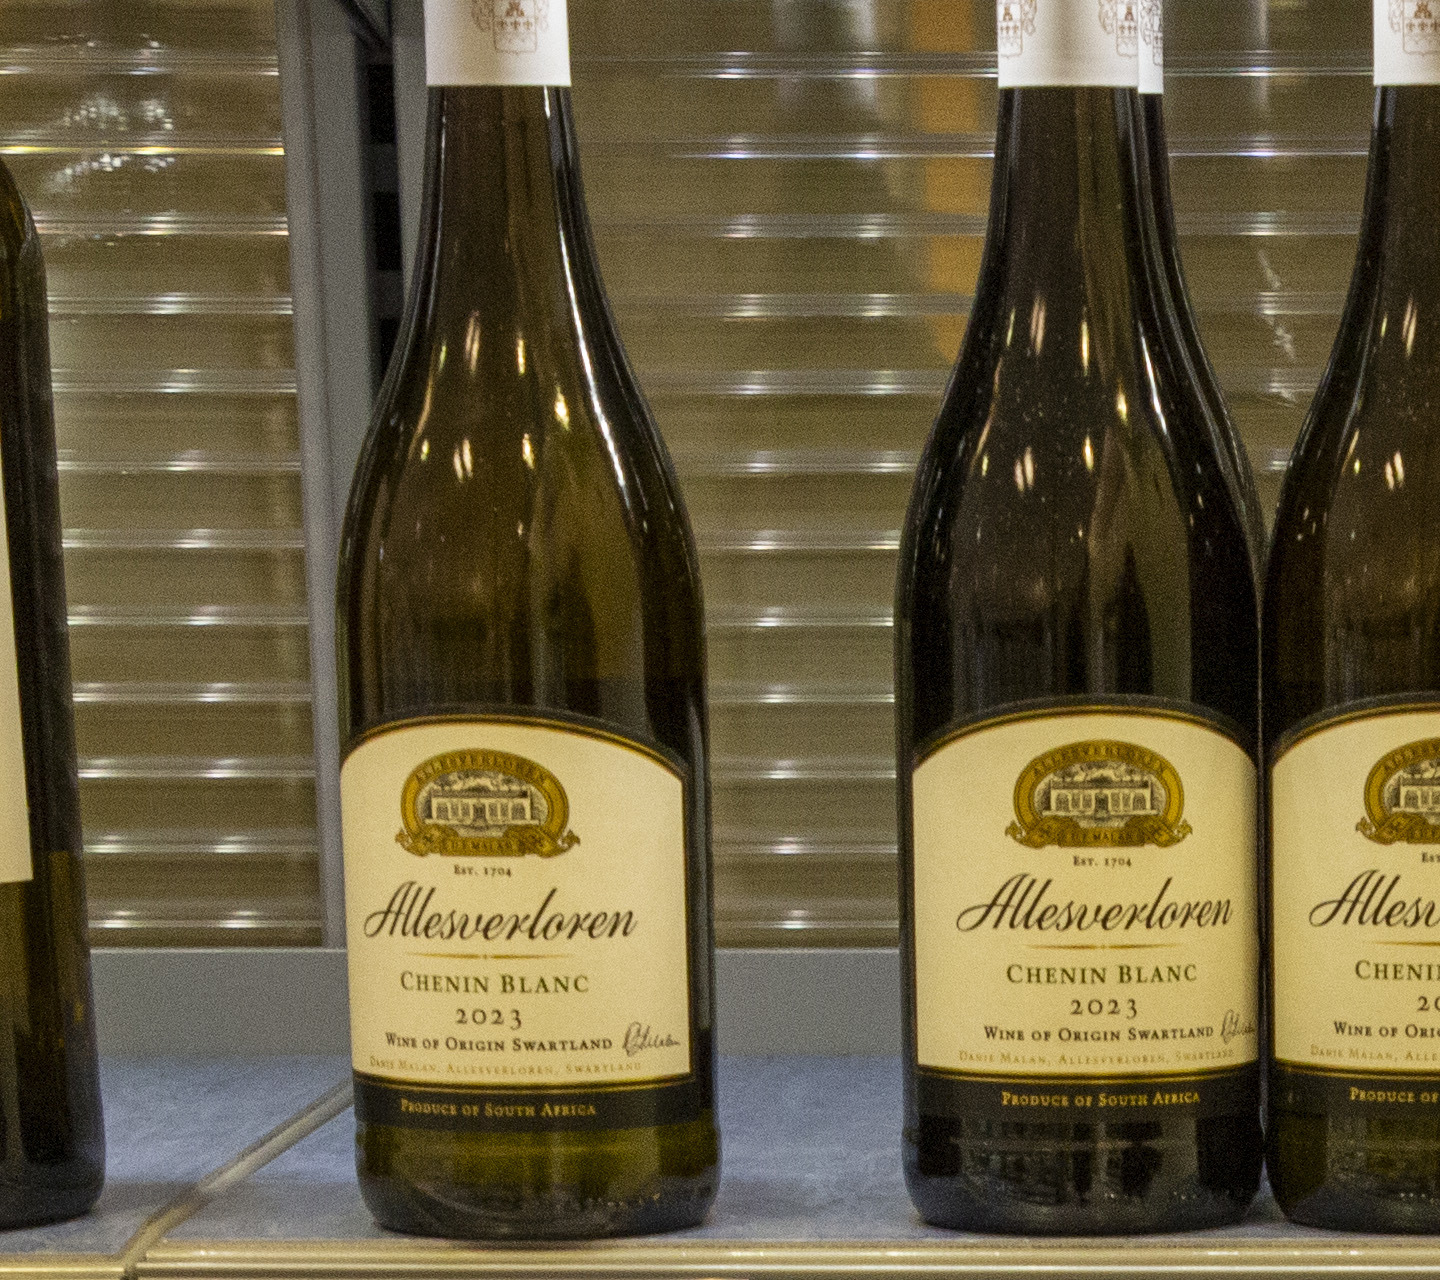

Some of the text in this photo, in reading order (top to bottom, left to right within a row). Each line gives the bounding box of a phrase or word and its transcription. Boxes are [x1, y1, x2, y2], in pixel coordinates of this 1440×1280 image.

[363, 879, 637, 942] Allesverloren
[957, 872, 1233, 935] Allesverloren
[401, 971, 590, 993] CHENIN BLANC
[1007, 963, 1198, 985] CHENIN BLANC
[456, 1008, 522, 1026] 2023
[1071, 999, 1137, 1018] 2023
[386, 1033, 416, 1050] WINE
[445, 1035, 506, 1053] ORIGIN
[513, 1036, 612, 1053] SWARTLAND
